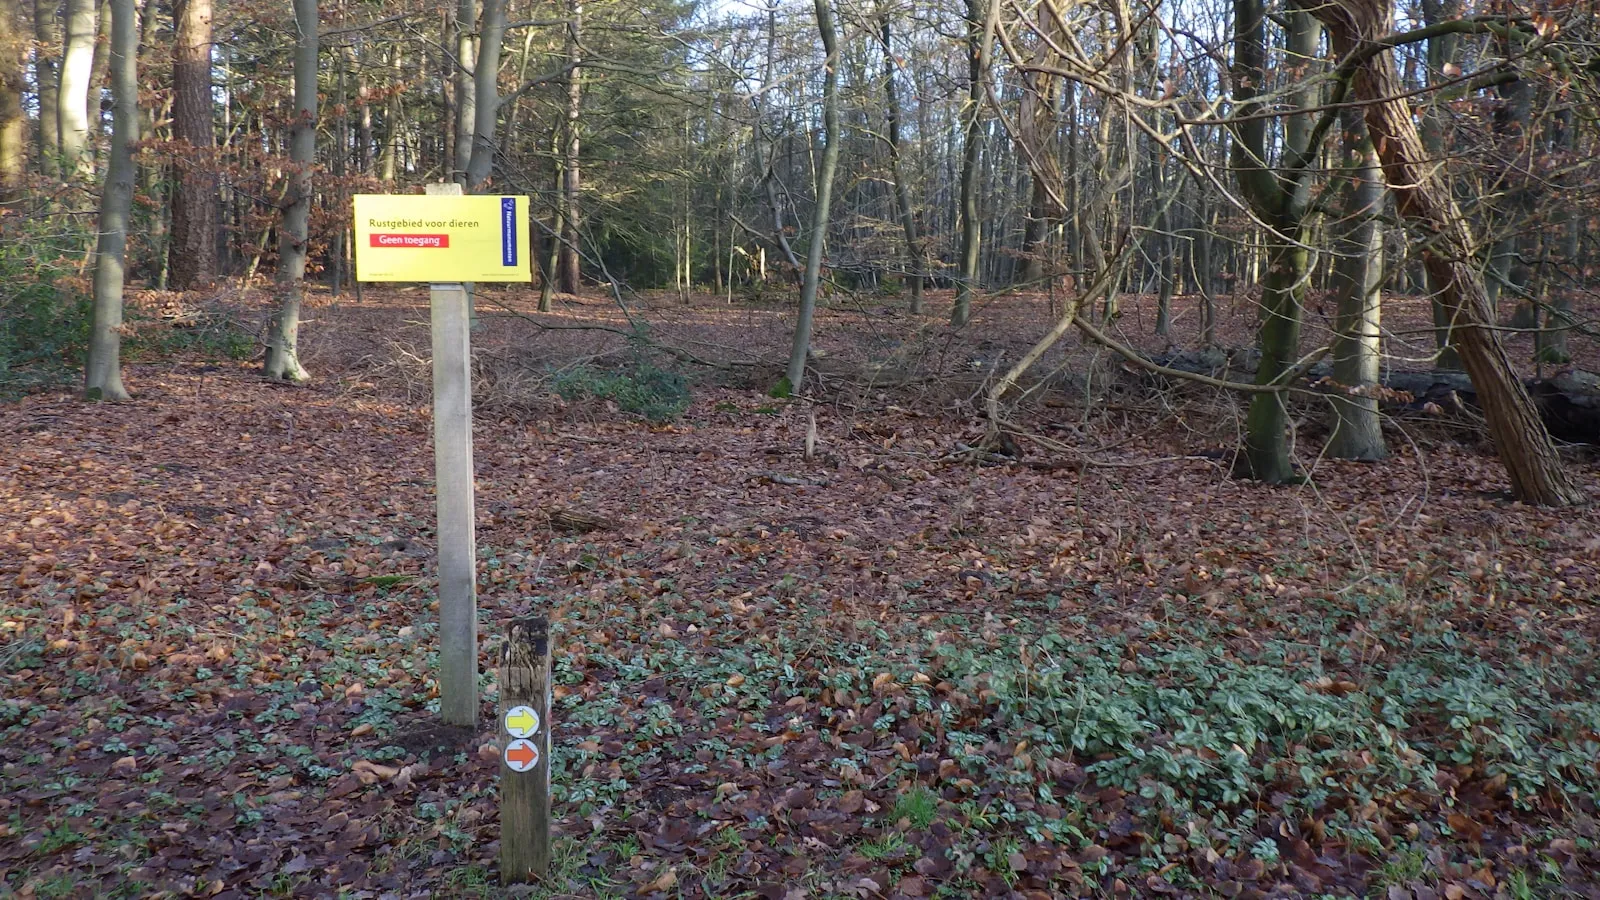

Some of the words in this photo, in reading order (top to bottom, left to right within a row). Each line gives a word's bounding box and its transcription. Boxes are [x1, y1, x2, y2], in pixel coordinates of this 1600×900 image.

[369, 218, 423, 229] Rustgebied
[425, 220, 447, 228] voor
[449, 219, 479, 228] dieren
[379, 235, 403, 244] Geen
[404, 236, 440, 247] toegang
